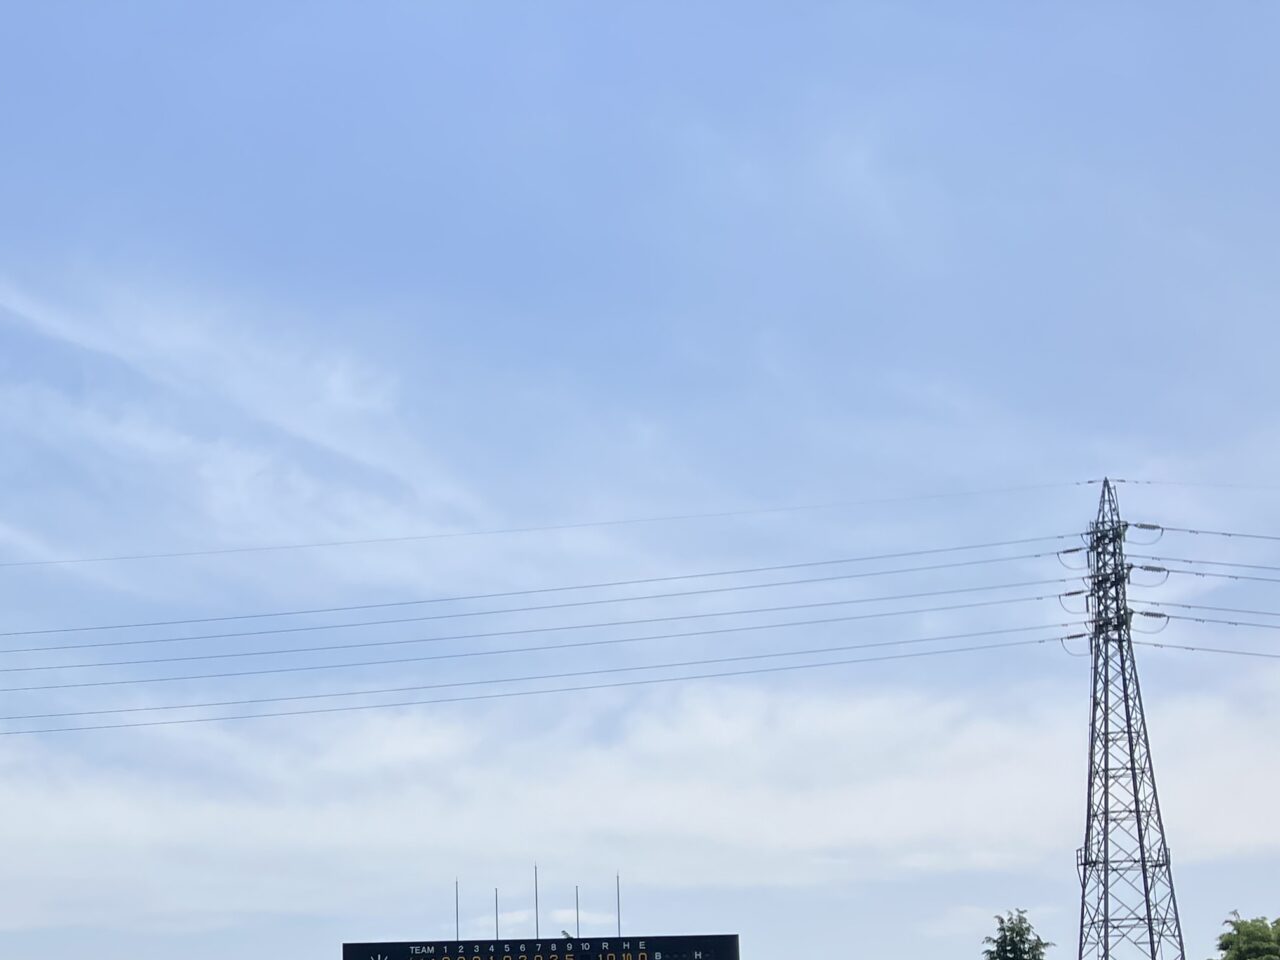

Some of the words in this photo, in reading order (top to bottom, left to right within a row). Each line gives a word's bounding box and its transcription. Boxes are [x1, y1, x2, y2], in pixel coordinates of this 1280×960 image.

[410, 946, 434, 954] TEAM
[474, 945, 479, 953] 3
[489, 945, 494, 953] 4
